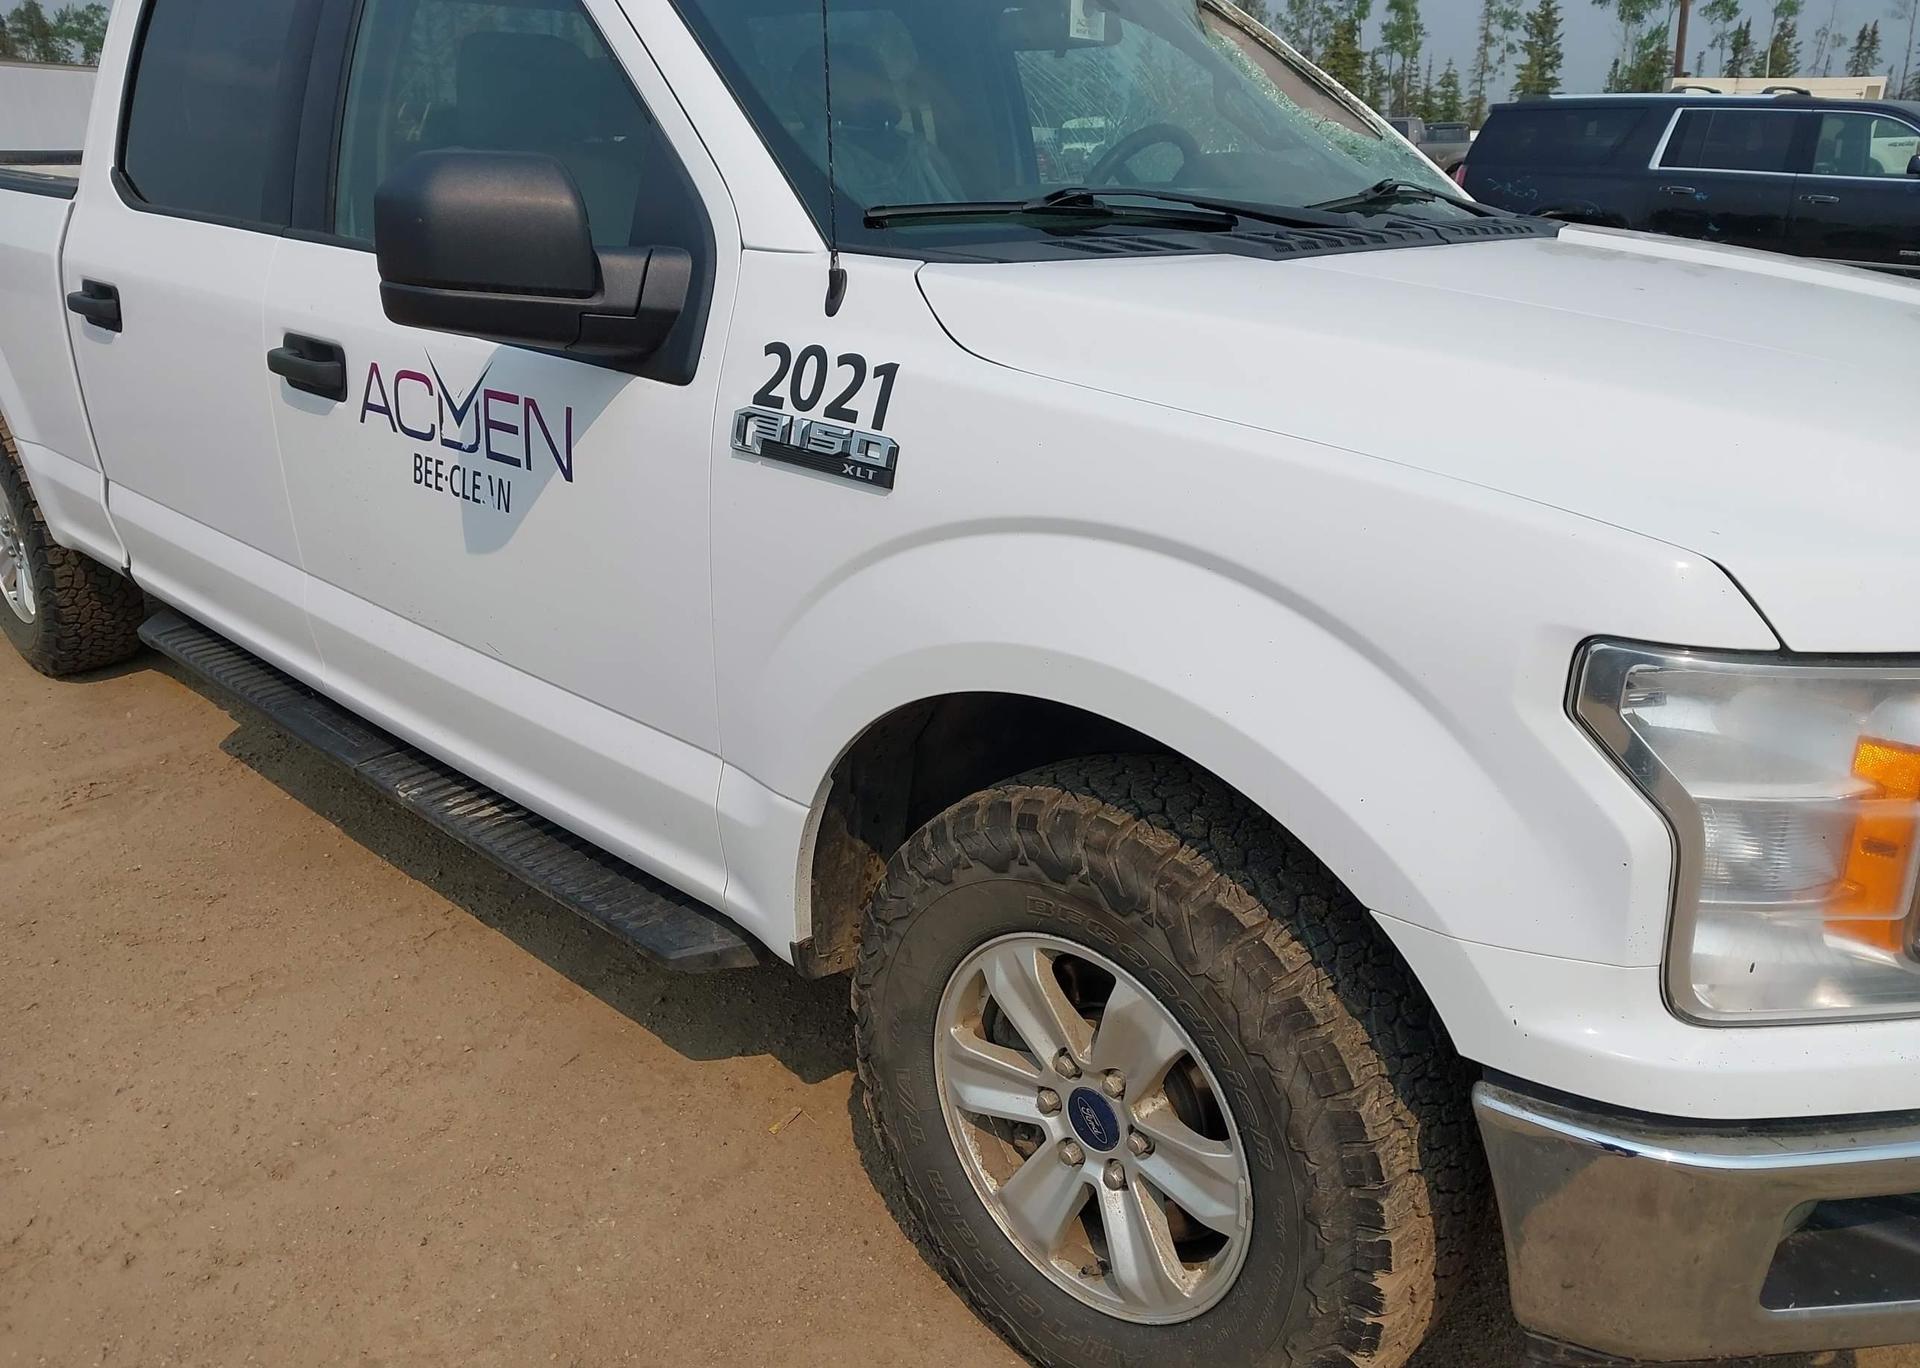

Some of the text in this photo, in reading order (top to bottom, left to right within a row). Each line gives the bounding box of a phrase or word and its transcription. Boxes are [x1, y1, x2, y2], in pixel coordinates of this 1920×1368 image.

[752, 341, 900, 431] 2021
[842, 463, 878, 480] XLT
[1081, 1106, 1103, 1136] Ford
